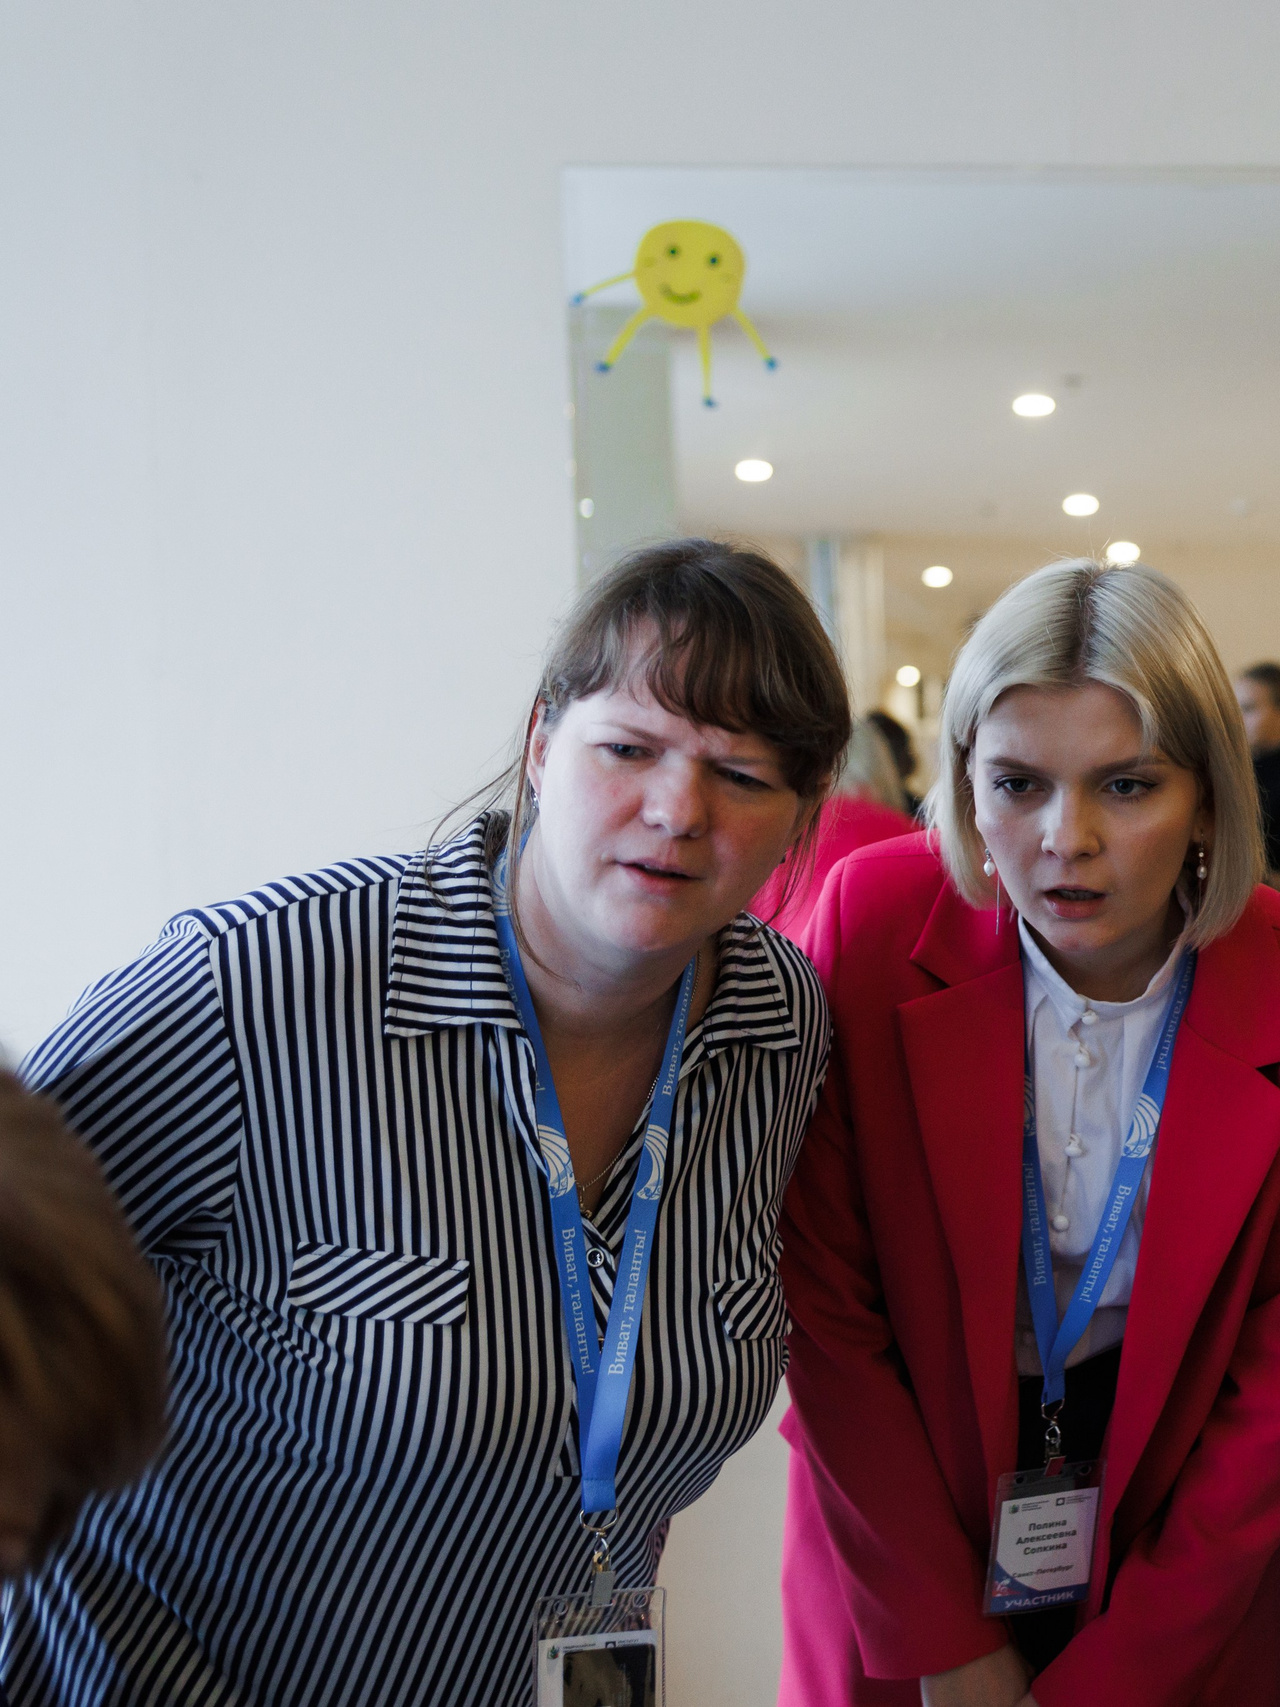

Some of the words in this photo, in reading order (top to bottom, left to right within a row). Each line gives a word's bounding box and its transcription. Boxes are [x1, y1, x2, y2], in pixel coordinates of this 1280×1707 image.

[661, 1040, 682, 1096] Виват,
[675, 958, 694, 1037] таланты
[1156, 998, 1184, 1071] таланты!
[1022, 1162, 1041, 1233] таланты!
[1102, 1185, 1132, 1233] Виват,
[1034, 1235, 1047, 1286] Виват,
[1079, 1234, 1113, 1303] таланты!
[562, 1227, 578, 1288] Виват,
[570, 1289, 595, 1375] таланты!
[608, 1317, 635, 1375] Виват,
[623, 1229, 647, 1315] таланты!
[1016, 1529, 1077, 1545] Алексеевна
[1023, 1542, 1068, 1556] Сопкина
[1028, 1519, 1067, 1531] Полина
[1012, 1564, 1074, 1578] Санкт-Петербург
[1005, 1591, 1074, 1608] УЧАСТНИК
